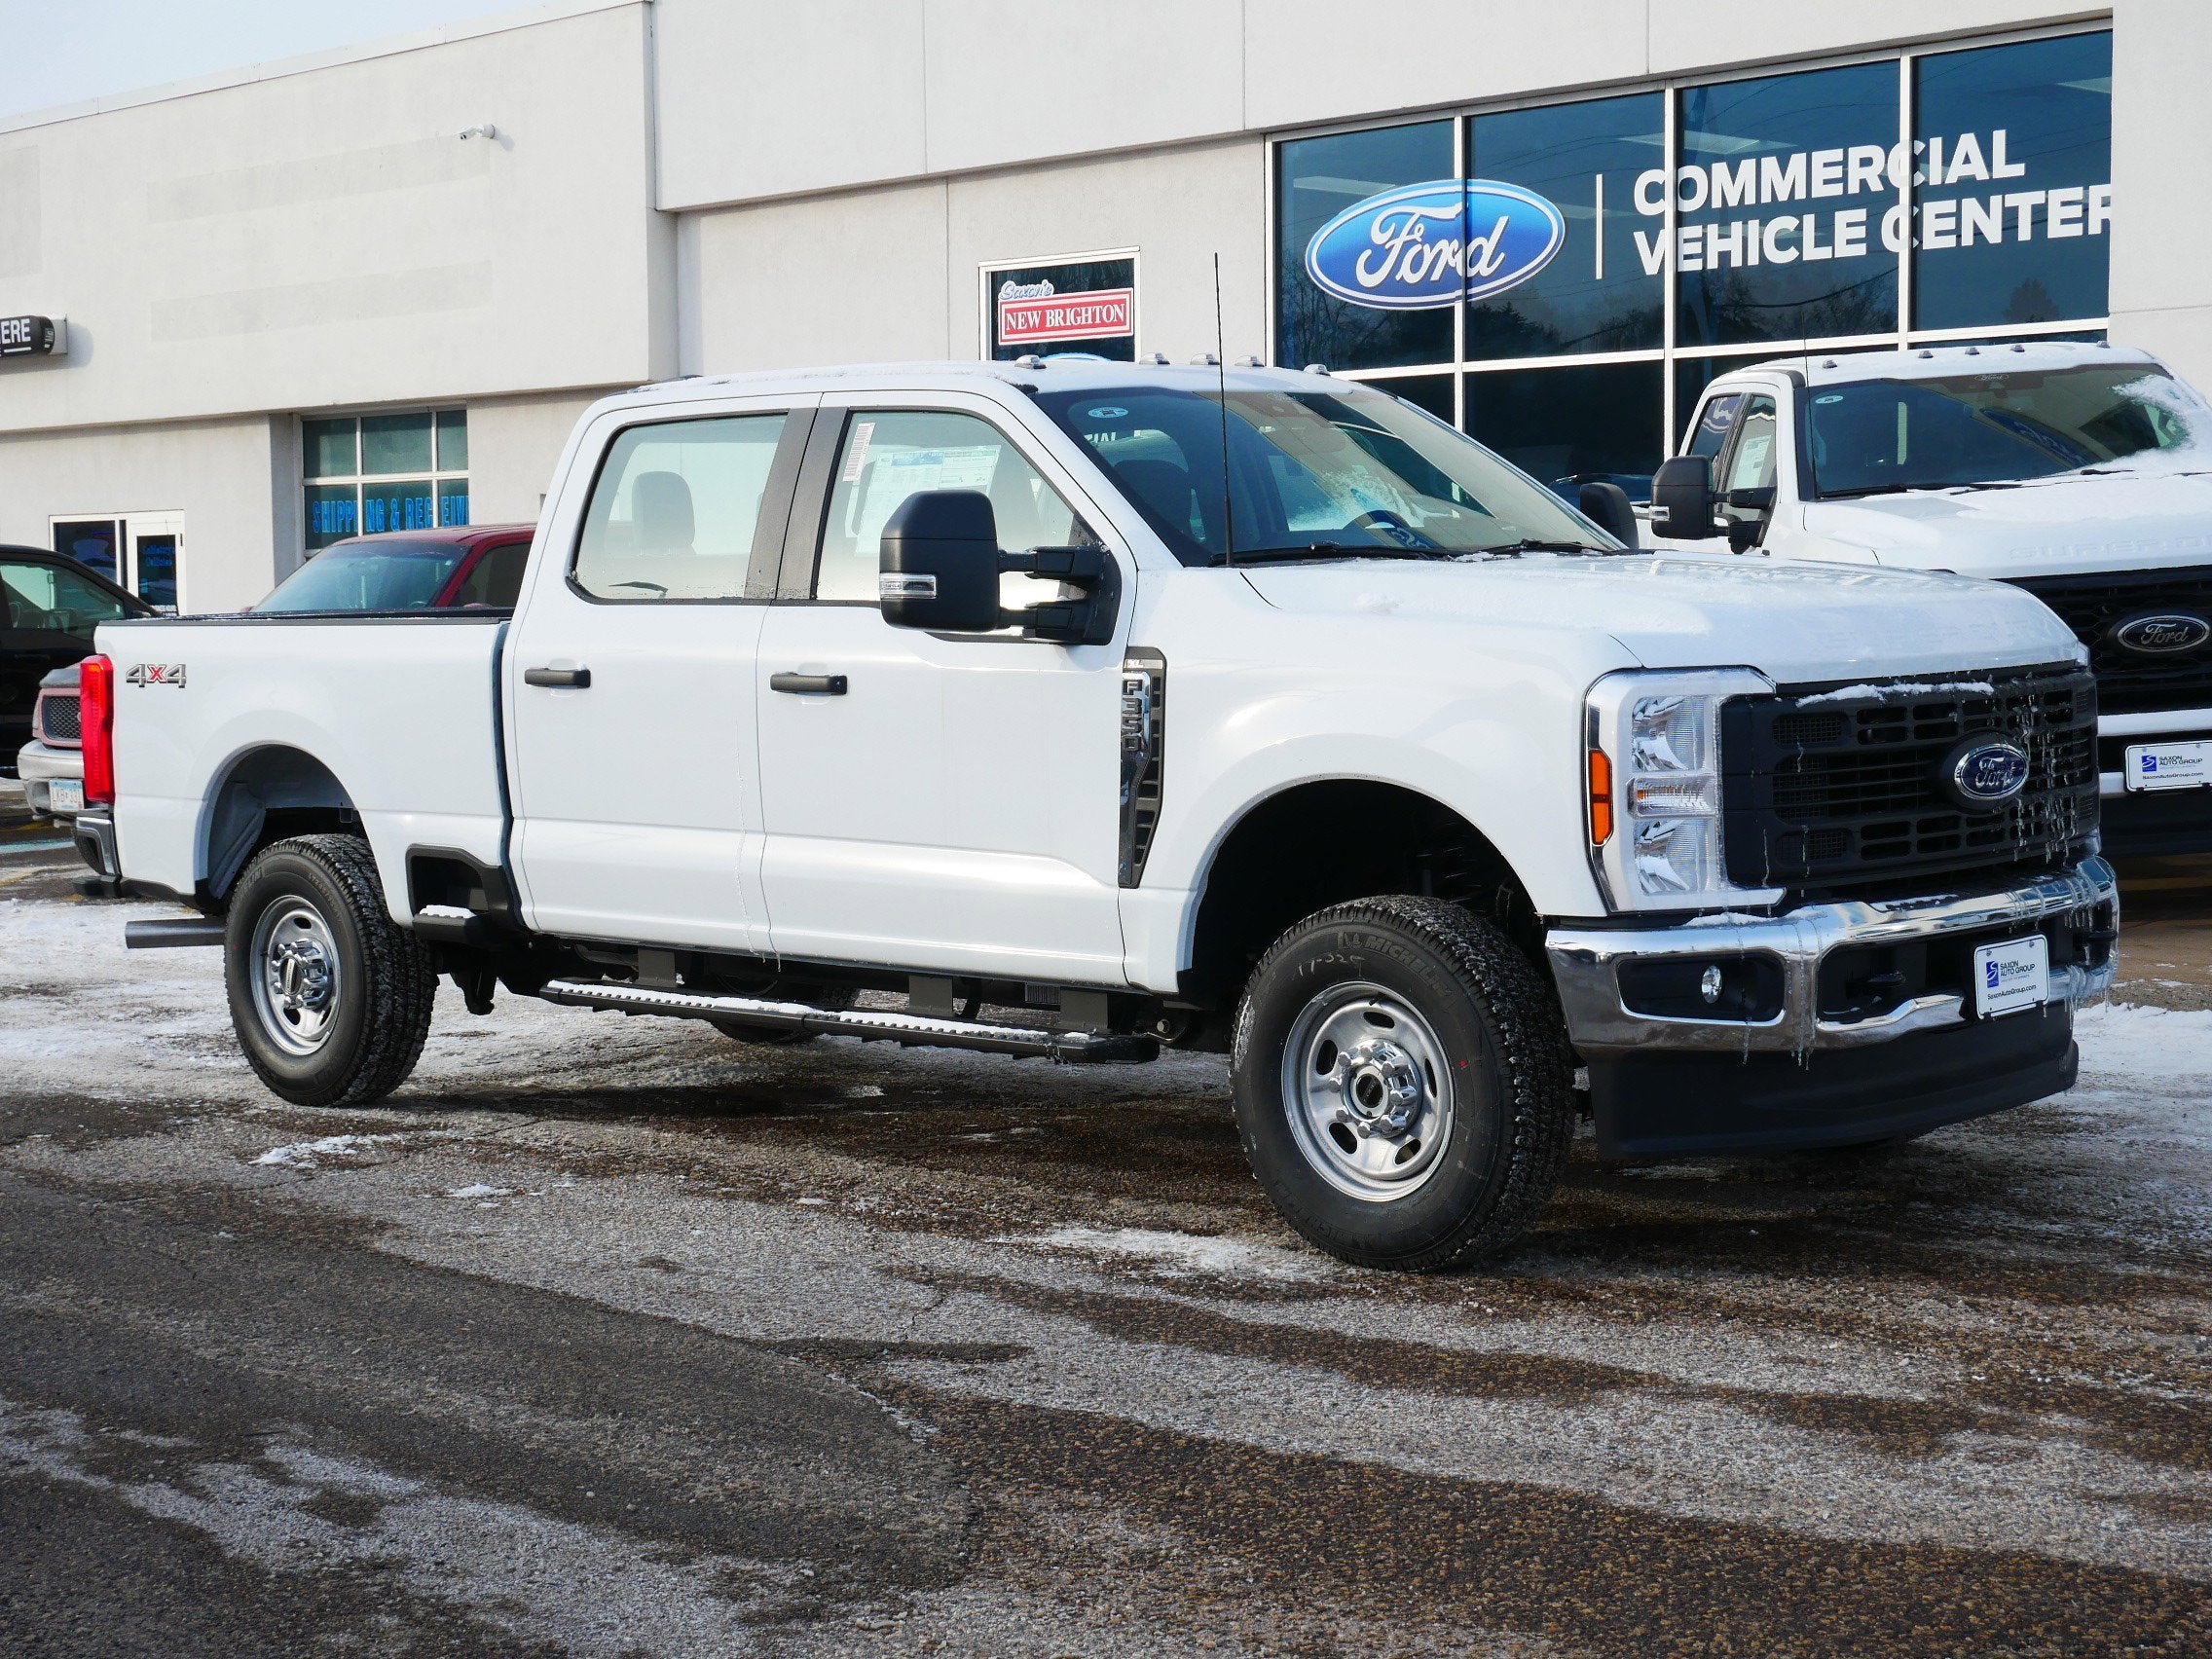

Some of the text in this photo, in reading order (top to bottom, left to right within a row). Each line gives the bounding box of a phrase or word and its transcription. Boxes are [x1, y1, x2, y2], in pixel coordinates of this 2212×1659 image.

[1634, 129, 2025, 216] COMMERCIAL
[1356, 201, 1509, 288] Ford
[1634, 207, 1867, 276] VEHICLE
[1000, 280, 1053, 301] Saxon's
[1006, 303, 1125, 332] NEW BRIGHTON
[0, 318, 31, 345] ERE
[313, 498, 385, 534] SHIPPING
[390, 498, 400, 533] &
[2141, 622, 2190, 645] Ford
[1126, 658, 1144, 669] XL
[1974, 756, 2014, 789] Ford
[2000, 960, 2019, 971] SAXON
[2000, 963, 2036, 977] AUTO GROUP
[1987, 983, 2037, 1001] SaxonAutoGroup.com
